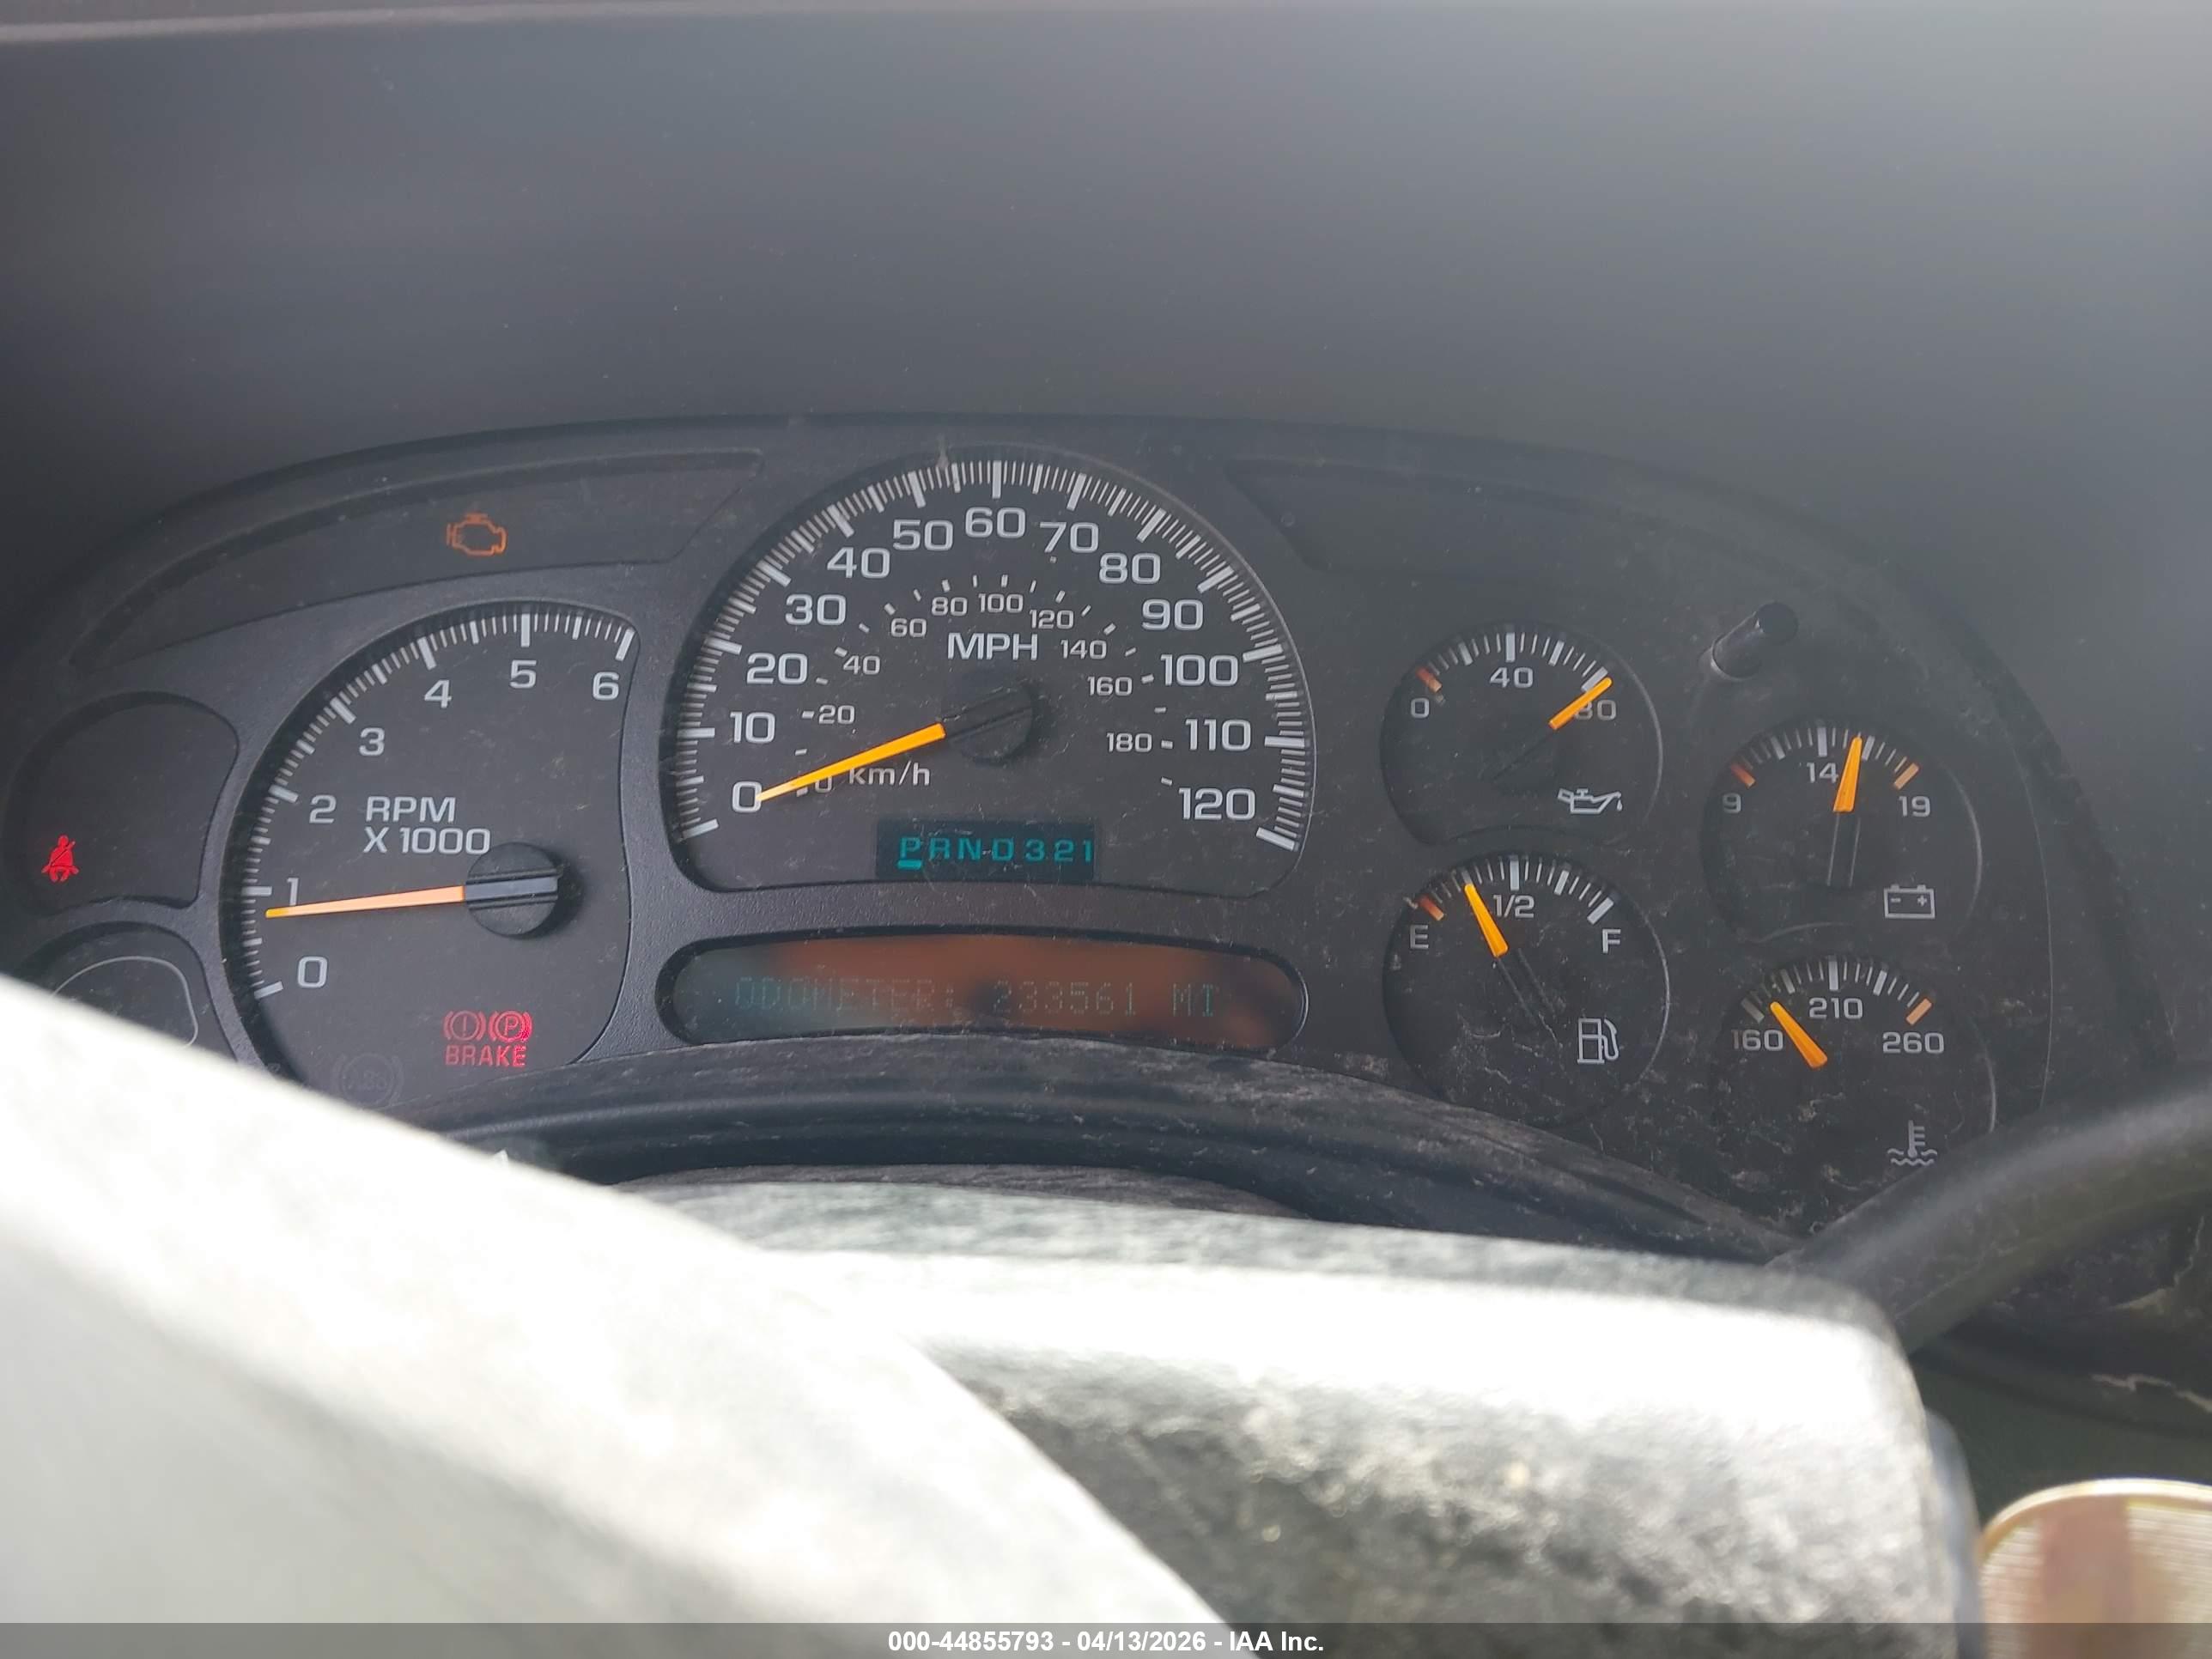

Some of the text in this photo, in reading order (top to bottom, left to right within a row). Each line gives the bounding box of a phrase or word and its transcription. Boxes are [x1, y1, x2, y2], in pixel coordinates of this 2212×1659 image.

[893, 520, 953, 550] 50
[964, 507, 1026, 538] 60
[1039, 521, 1099, 554] 70
[827, 548, 890, 579] 40
[1099, 552, 1161, 584] 80
[785, 594, 846, 626] 30
[932, 597, 968, 617] 80
[979, 593, 1024, 613] 100
[1141, 599, 1203, 631] 90
[890, 618, 927, 637] 60
[1030, 611, 1074, 629] 120
[947, 632, 1038, 660] MPH
[1060, 640, 1108, 660] 140
[510, 660, 538, 688] 5
[746, 653, 807, 684] 20
[842, 655, 880, 675] 40
[1160, 653, 1238, 686] 100
[1489, 667, 1534, 689] 40
[424, 680, 452, 708] 4
[592, 672, 619, 700] 6
[1087, 676, 1132, 696] 160
[818, 705, 855, 724] 20
[1411, 699, 1430, 719] 0
[730, 712, 775, 743] 10
[1185, 719, 1251, 750] 110
[359, 727, 386, 756] 3
[1106, 732, 1152, 752] 180
[848, 761, 930, 787] km/h
[1805, 762, 1838, 783] 14
[309, 795, 337, 823] 2
[366, 797, 456, 823] RPM
[732, 781, 763, 813] 0
[1178, 787, 1255, 820] 120
[1722, 793, 1741, 813] 9
[1898, 796, 1930, 817] 19
[363, 827, 491, 854] X 1000
[287, 878, 299, 906] 1
[1493, 895, 1534, 920] 1/2
[1409, 925, 1430, 950] E
[1601, 928, 1621, 953] F
[297, 956, 327, 988] 0
[994, 981, 1137, 1017] 233561
[1172, 983, 1213, 1017] MI
[1808, 998, 1863, 1020] 210
[1731, 1029, 1784, 1052] 160
[1882, 1031, 1945, 1054] 260
[445, 1044, 527, 1068] BRAKE
